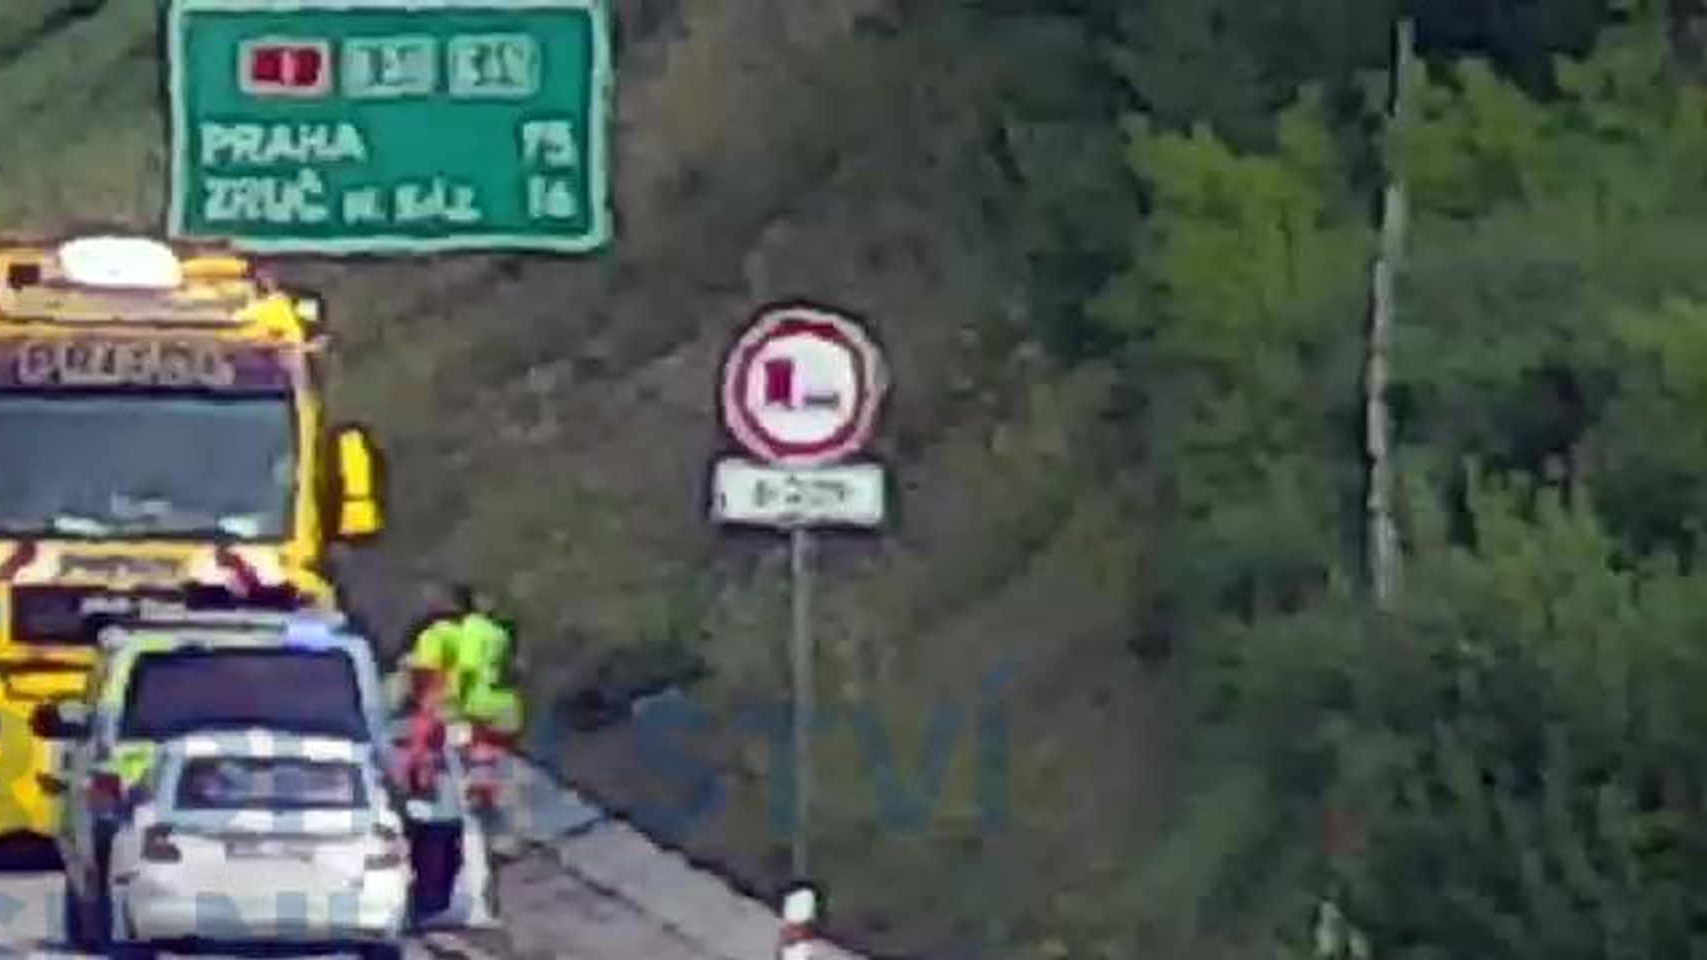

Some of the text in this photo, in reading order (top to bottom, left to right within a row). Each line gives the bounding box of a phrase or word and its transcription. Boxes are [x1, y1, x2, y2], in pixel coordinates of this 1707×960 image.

[199, 121, 367, 165] PRAHA
[203, 168, 329, 223] ZRUČ
[527, 175, 578, 219] 16
